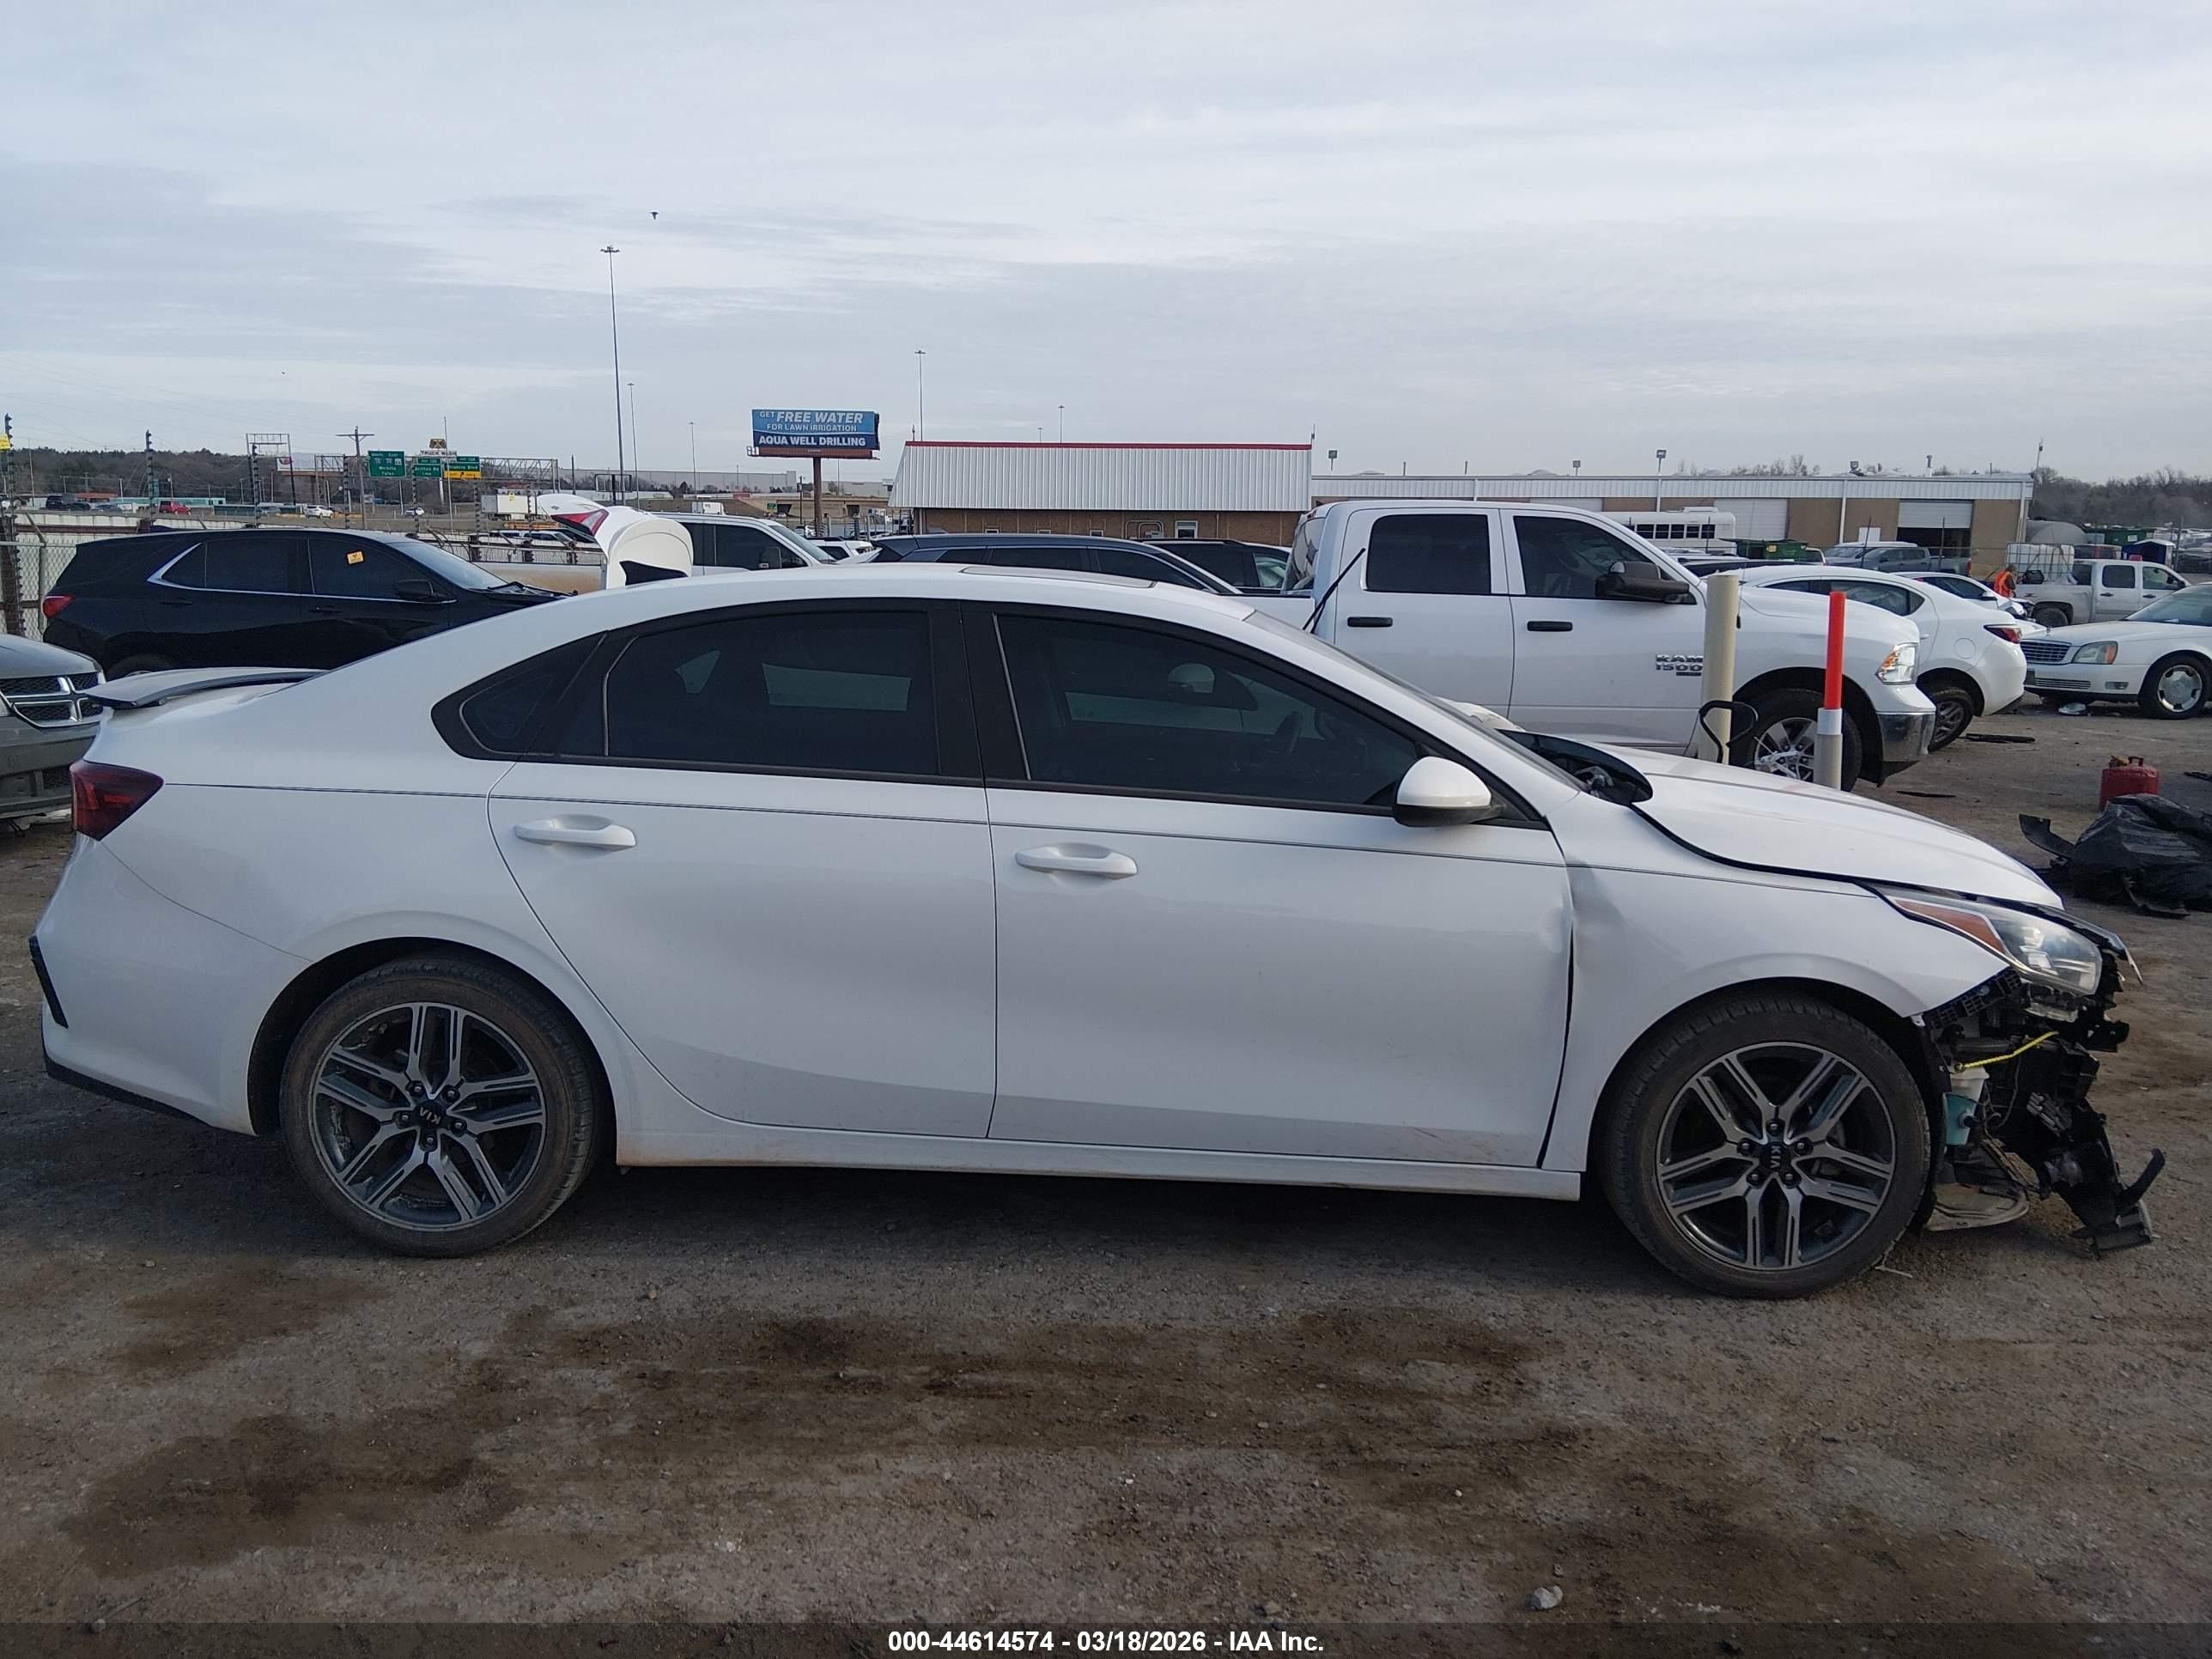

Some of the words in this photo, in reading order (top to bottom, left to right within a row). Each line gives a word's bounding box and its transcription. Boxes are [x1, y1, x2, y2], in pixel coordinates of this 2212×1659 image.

[776, 411, 811, 423] FREE
[815, 412, 863, 424] WATER
[758, 435, 788, 445] AQUA
[789, 436, 817, 446] WELL
[819, 436, 866, 447] DRILLING
[1656, 654, 1704, 663] RAM
[420, 1107, 441, 1125] KIA
[1771, 1146, 1782, 1169] KIA
